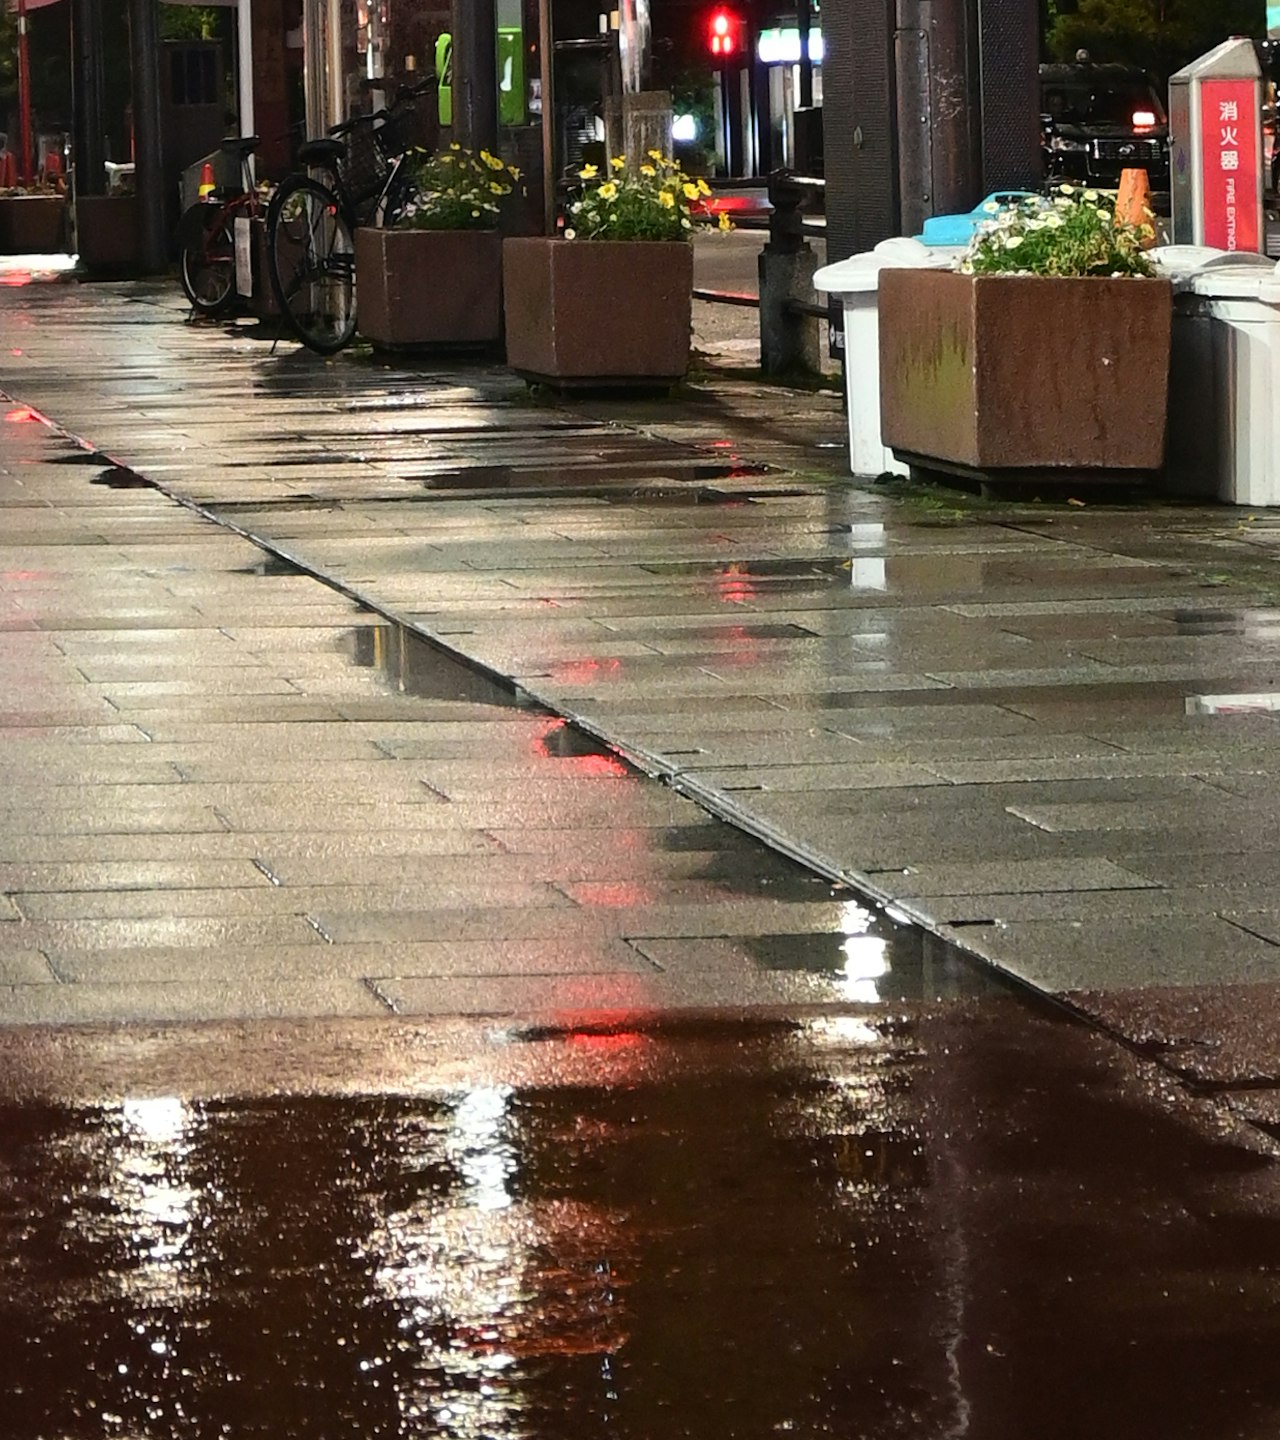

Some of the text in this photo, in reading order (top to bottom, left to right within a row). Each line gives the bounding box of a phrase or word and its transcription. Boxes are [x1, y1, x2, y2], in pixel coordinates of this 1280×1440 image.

[1219, 101, 1240, 172] 消火器
[1226, 178, 1237, 251] FIRE EXTING
